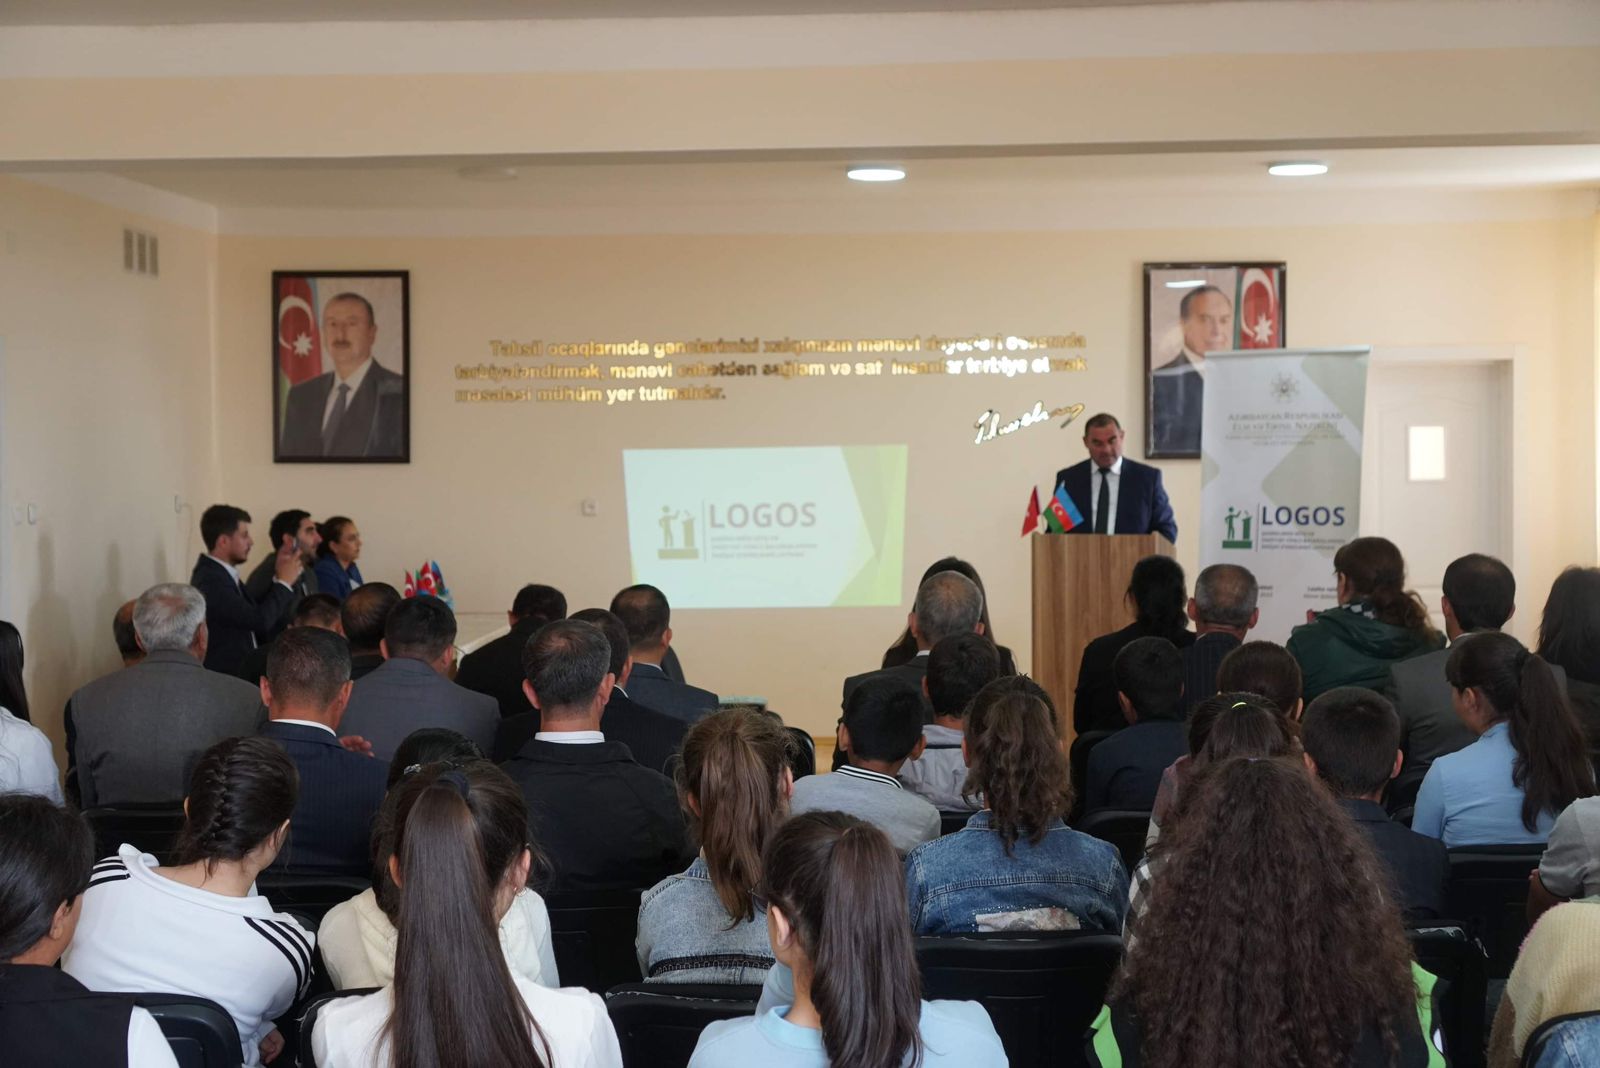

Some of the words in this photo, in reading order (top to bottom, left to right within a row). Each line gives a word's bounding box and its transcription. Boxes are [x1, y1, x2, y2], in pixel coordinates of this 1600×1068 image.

[547, 340, 649, 359] ocaqlarında
[857, 335, 920, 352] mənəvi
[610, 363, 673, 379] mənəvi
[830, 362, 850, 376] və
[537, 385, 602, 402] mühüm
[606, 387, 635, 405] yer
[709, 503, 817, 528] LOGOS
[1262, 506, 1345, 526] LOGOS
